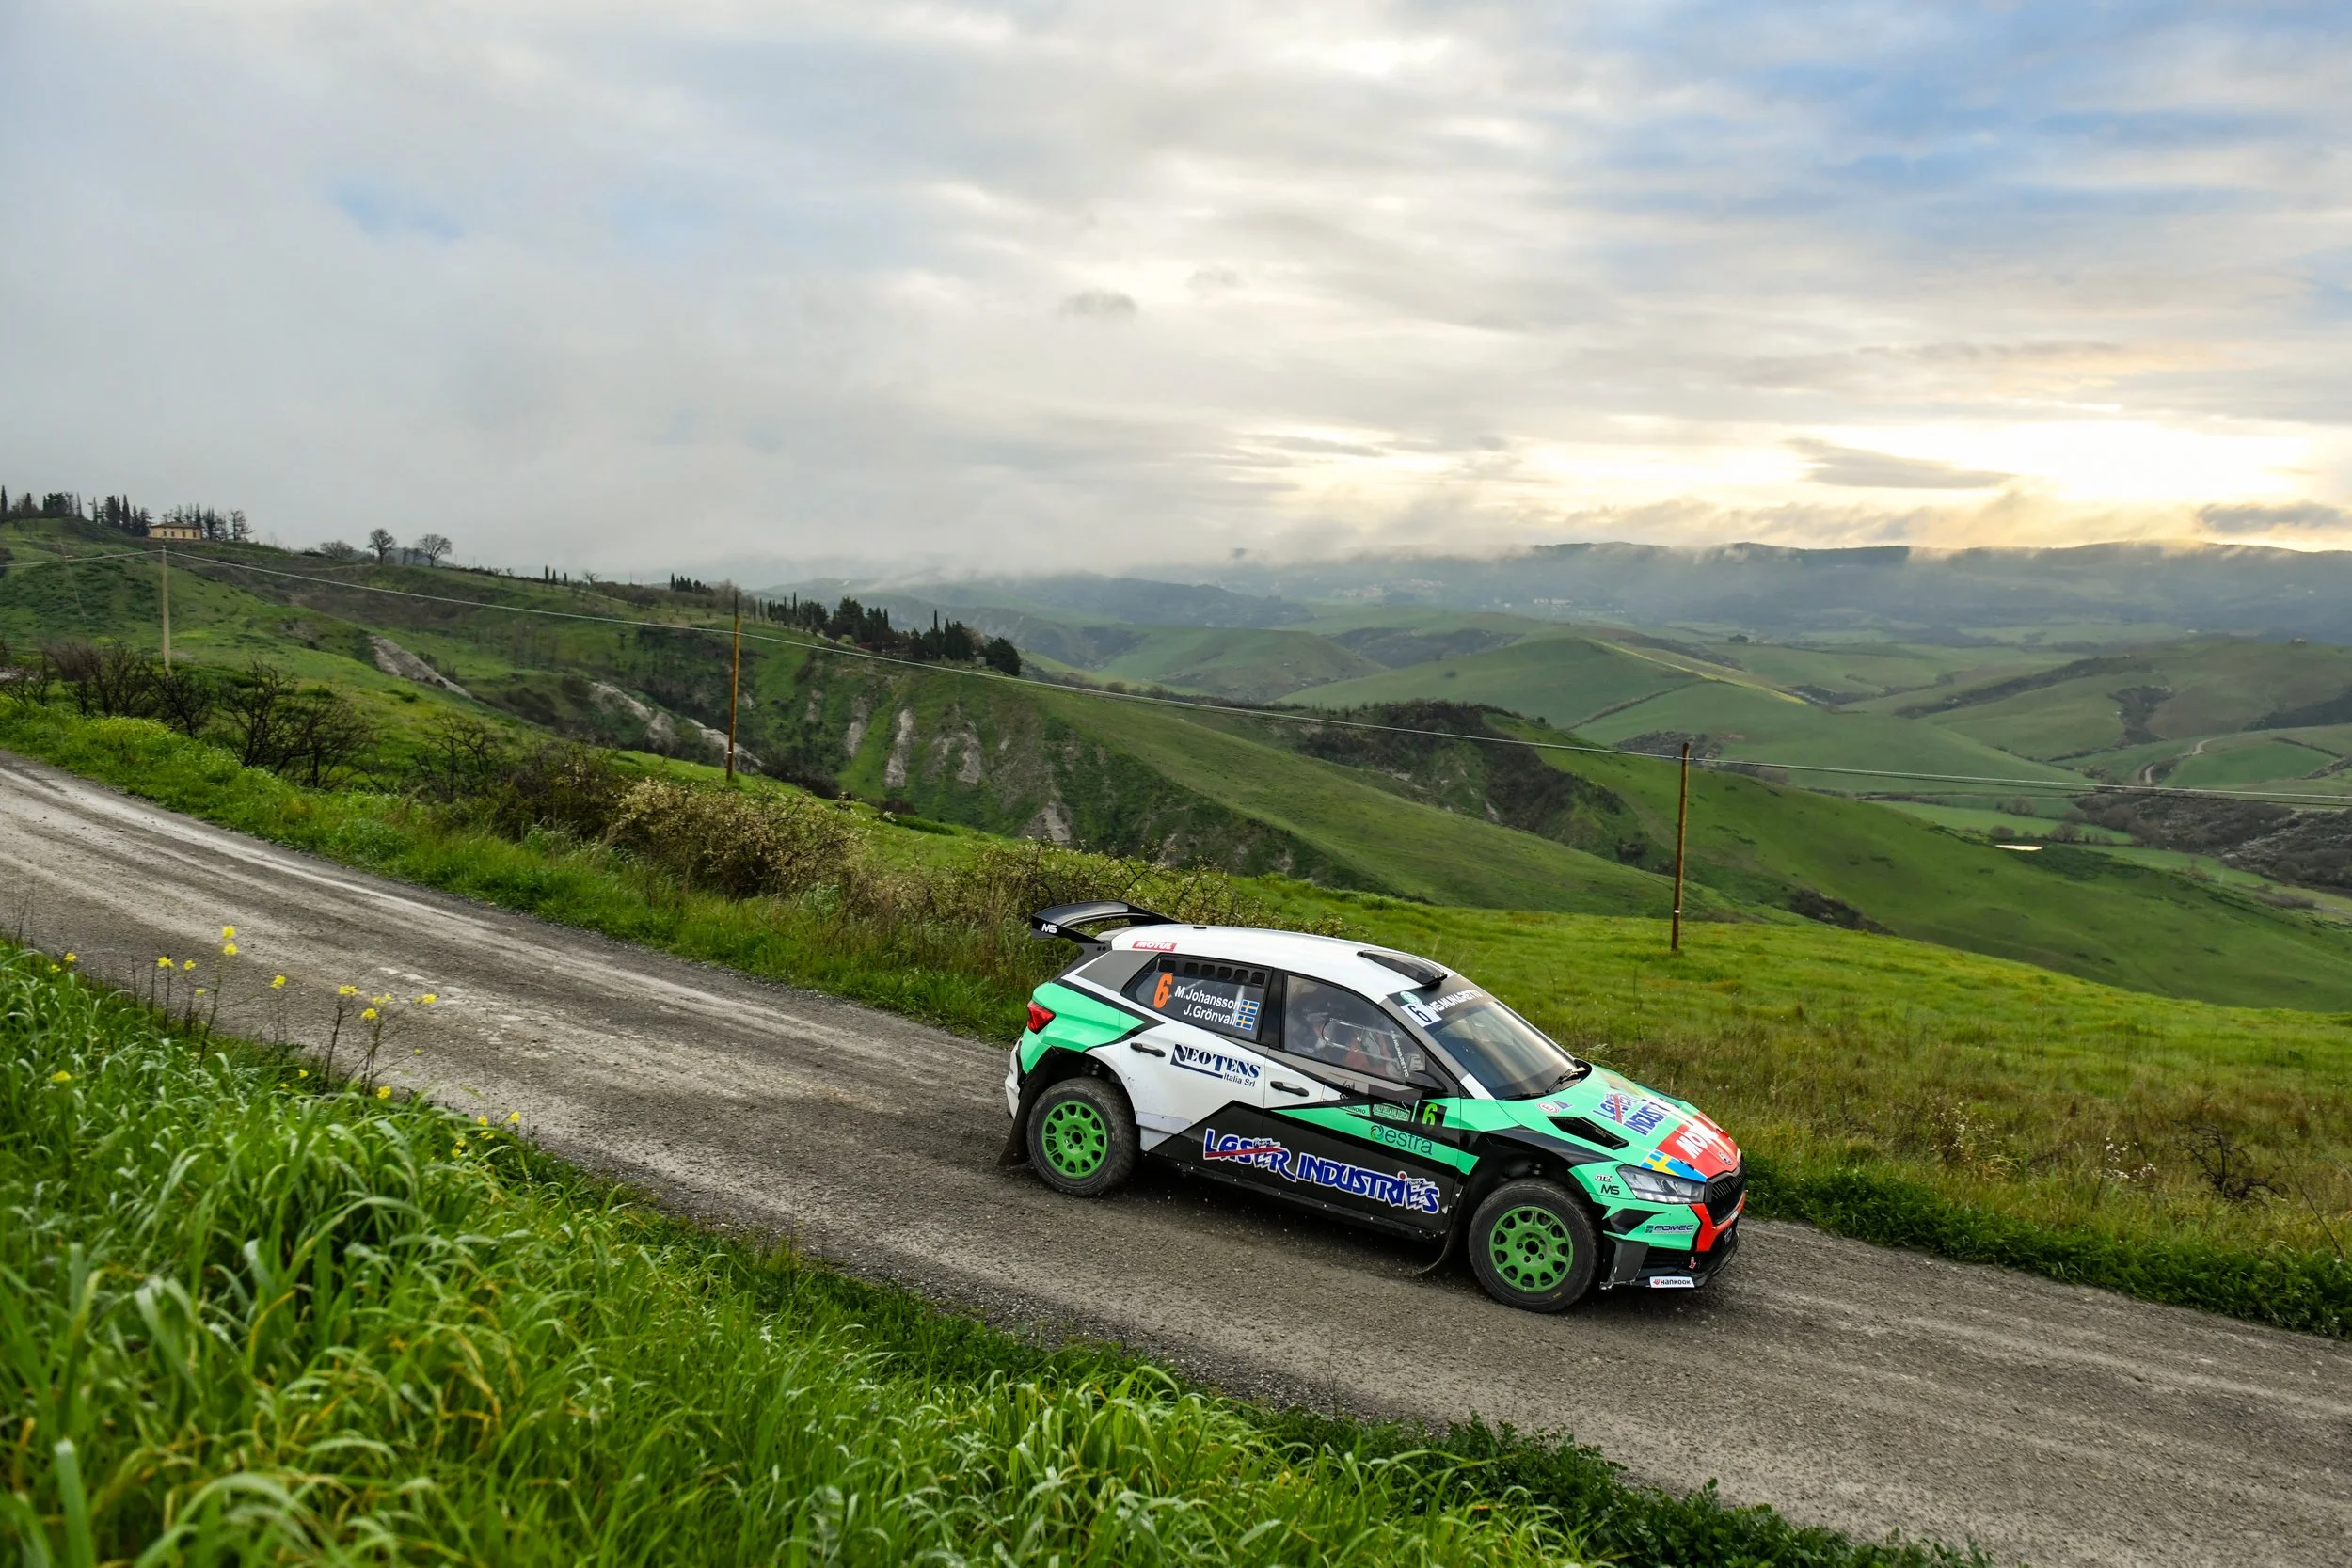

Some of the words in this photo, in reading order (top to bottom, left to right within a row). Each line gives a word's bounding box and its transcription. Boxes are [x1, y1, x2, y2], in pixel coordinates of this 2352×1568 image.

[1136, 941, 1173, 950] MOTUL
[1153, 972, 1174, 1009] 6
[1174, 985, 1242, 1011] M.Johansson
[1183, 1004, 1236, 1026] J.Grönvall
[1407, 1005, 1433, 1023] 6
[1170, 1043, 1261, 1079] NEOTENS
[1223, 1072, 1243, 1085] Italia
[1244, 1078, 1256, 1088] Srl
[1422, 1103, 1438, 1126] 6
[1384, 1128, 1433, 1156] estra
[1203, 1128, 1297, 1183] LASER
[1295, 1152, 1441, 1214] INDUSTRIES
[1600, 1184, 1620, 1196] MS
